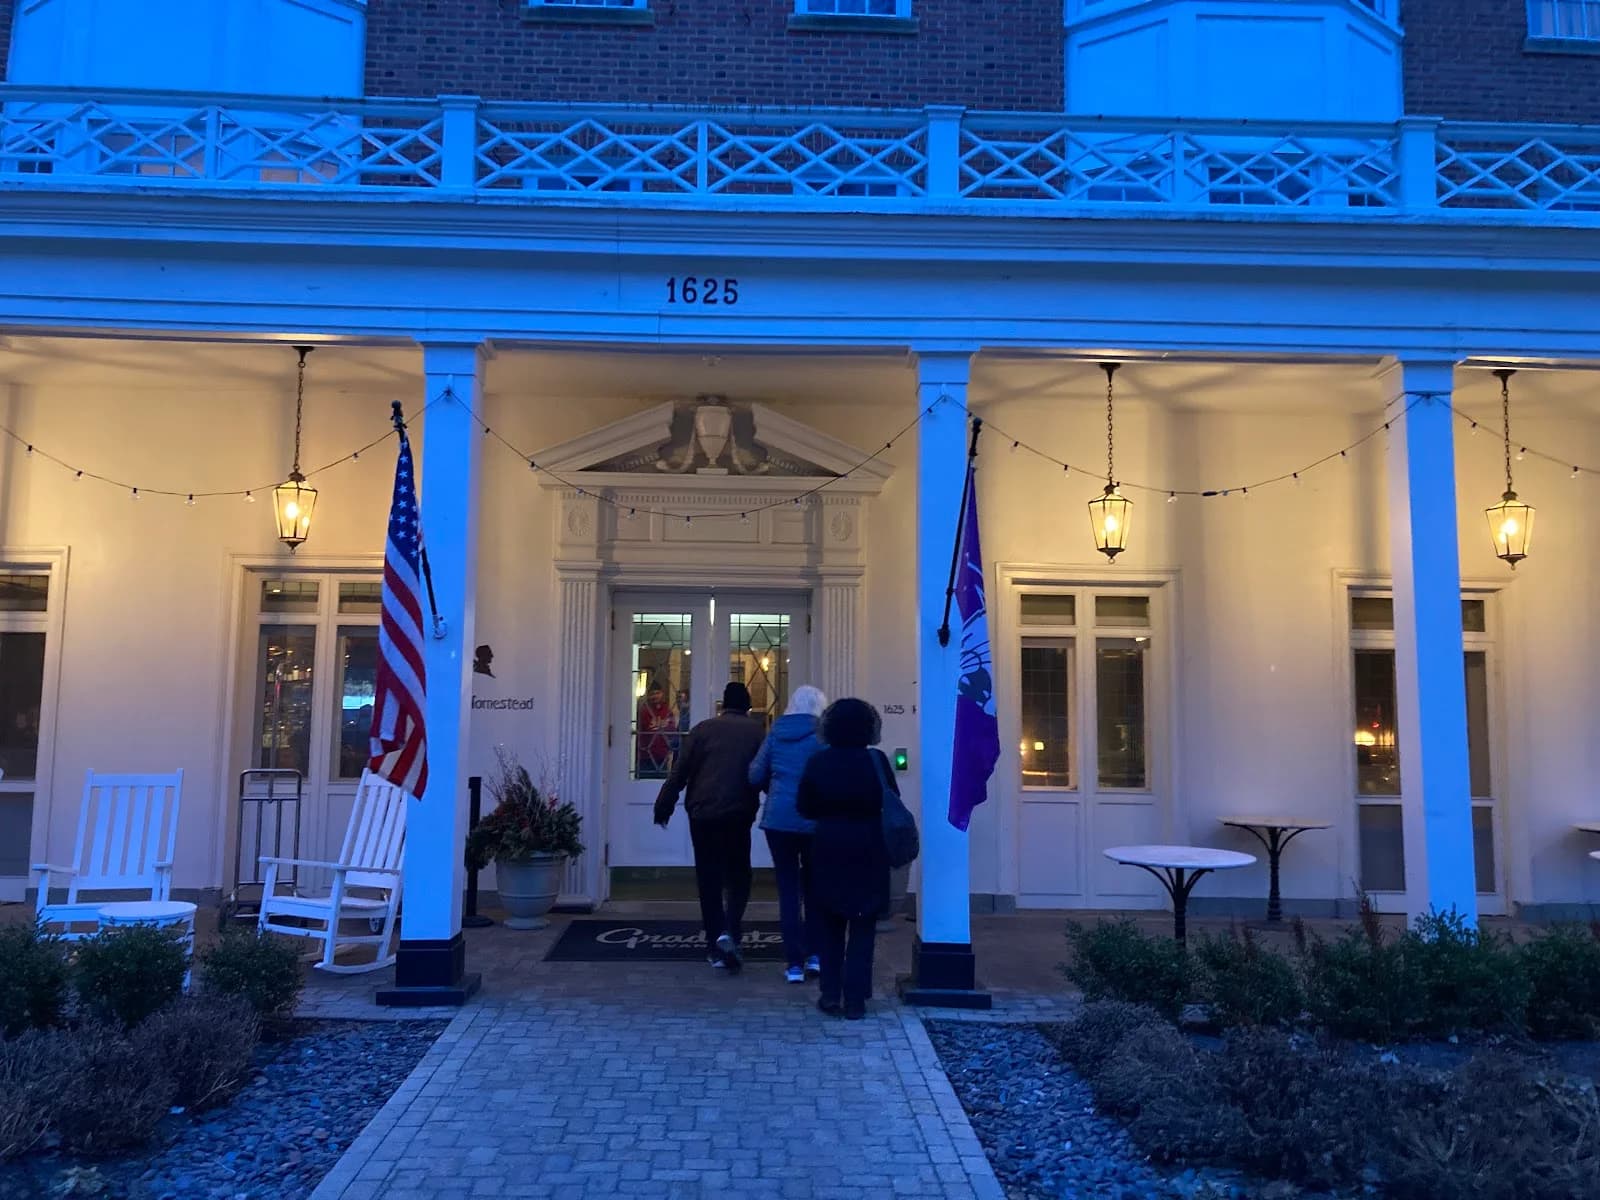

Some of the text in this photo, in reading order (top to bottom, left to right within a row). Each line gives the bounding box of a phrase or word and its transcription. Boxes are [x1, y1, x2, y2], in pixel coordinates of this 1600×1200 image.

[666, 276, 739, 305] 1625
[883, 704, 905, 715] 1625
[596, 927, 784, 948] Gradte
